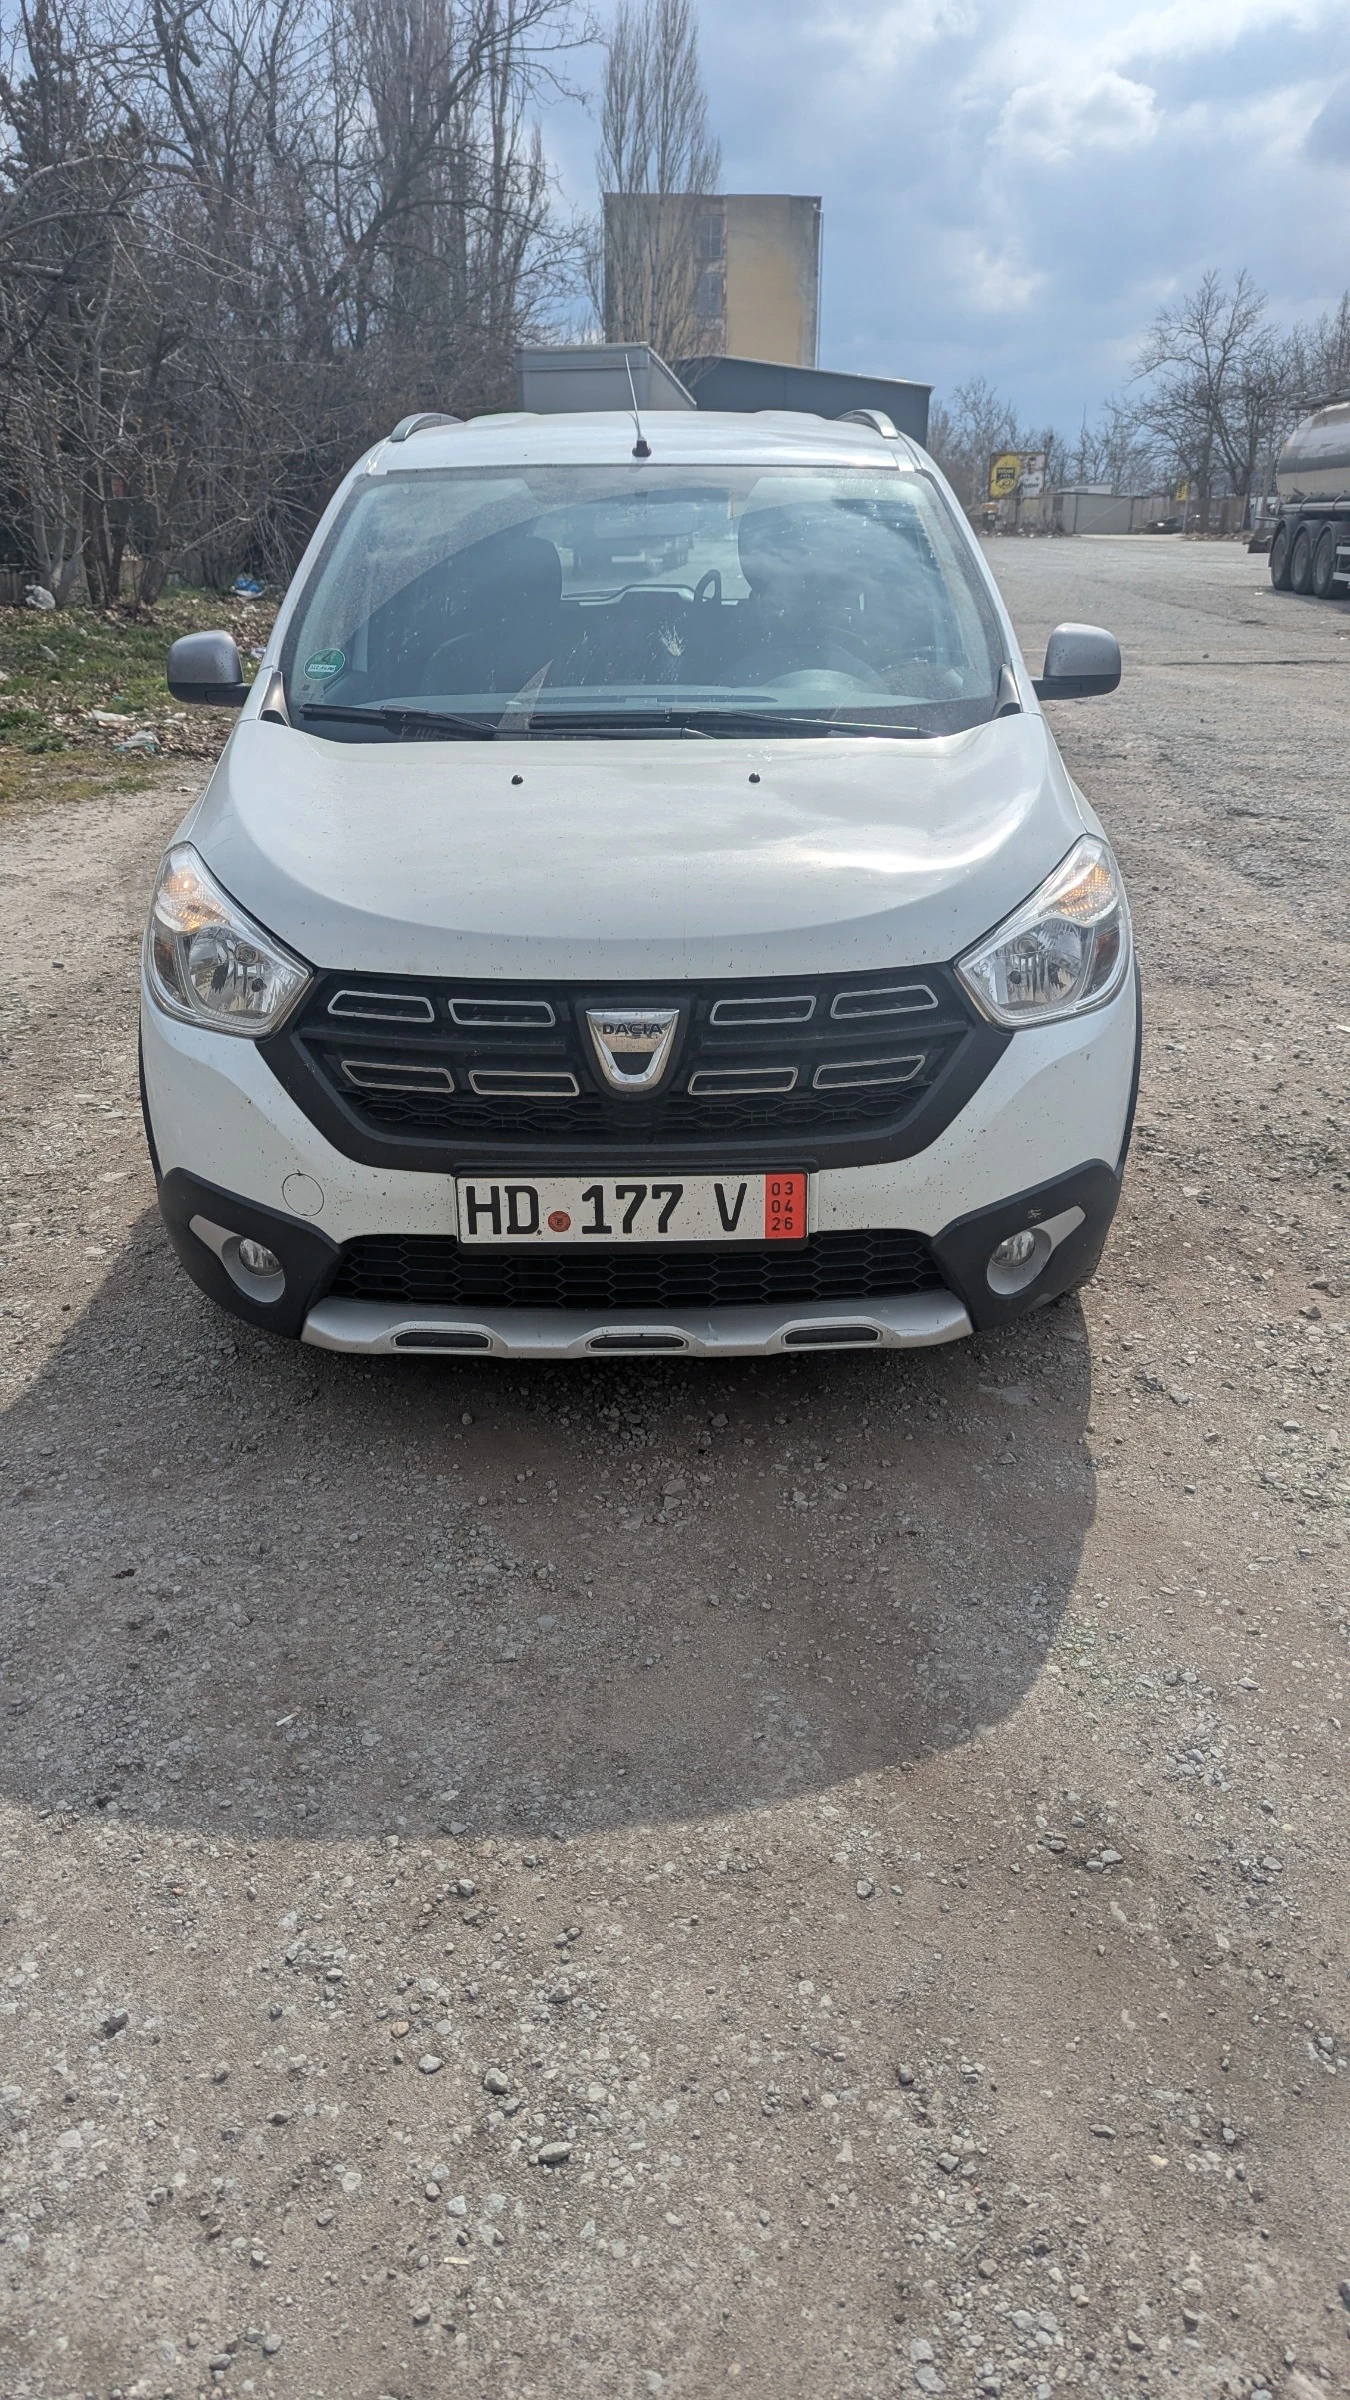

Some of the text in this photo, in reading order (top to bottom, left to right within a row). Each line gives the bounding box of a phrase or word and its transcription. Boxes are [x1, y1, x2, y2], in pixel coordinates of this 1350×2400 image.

[602, 1023, 663, 1035] DACIA
[771, 1182, 794, 1196] 03
[466, 1183, 747, 1235] HD 177 V
[771, 1199, 794, 1213] 04
[771, 1216, 794, 1231] 26
